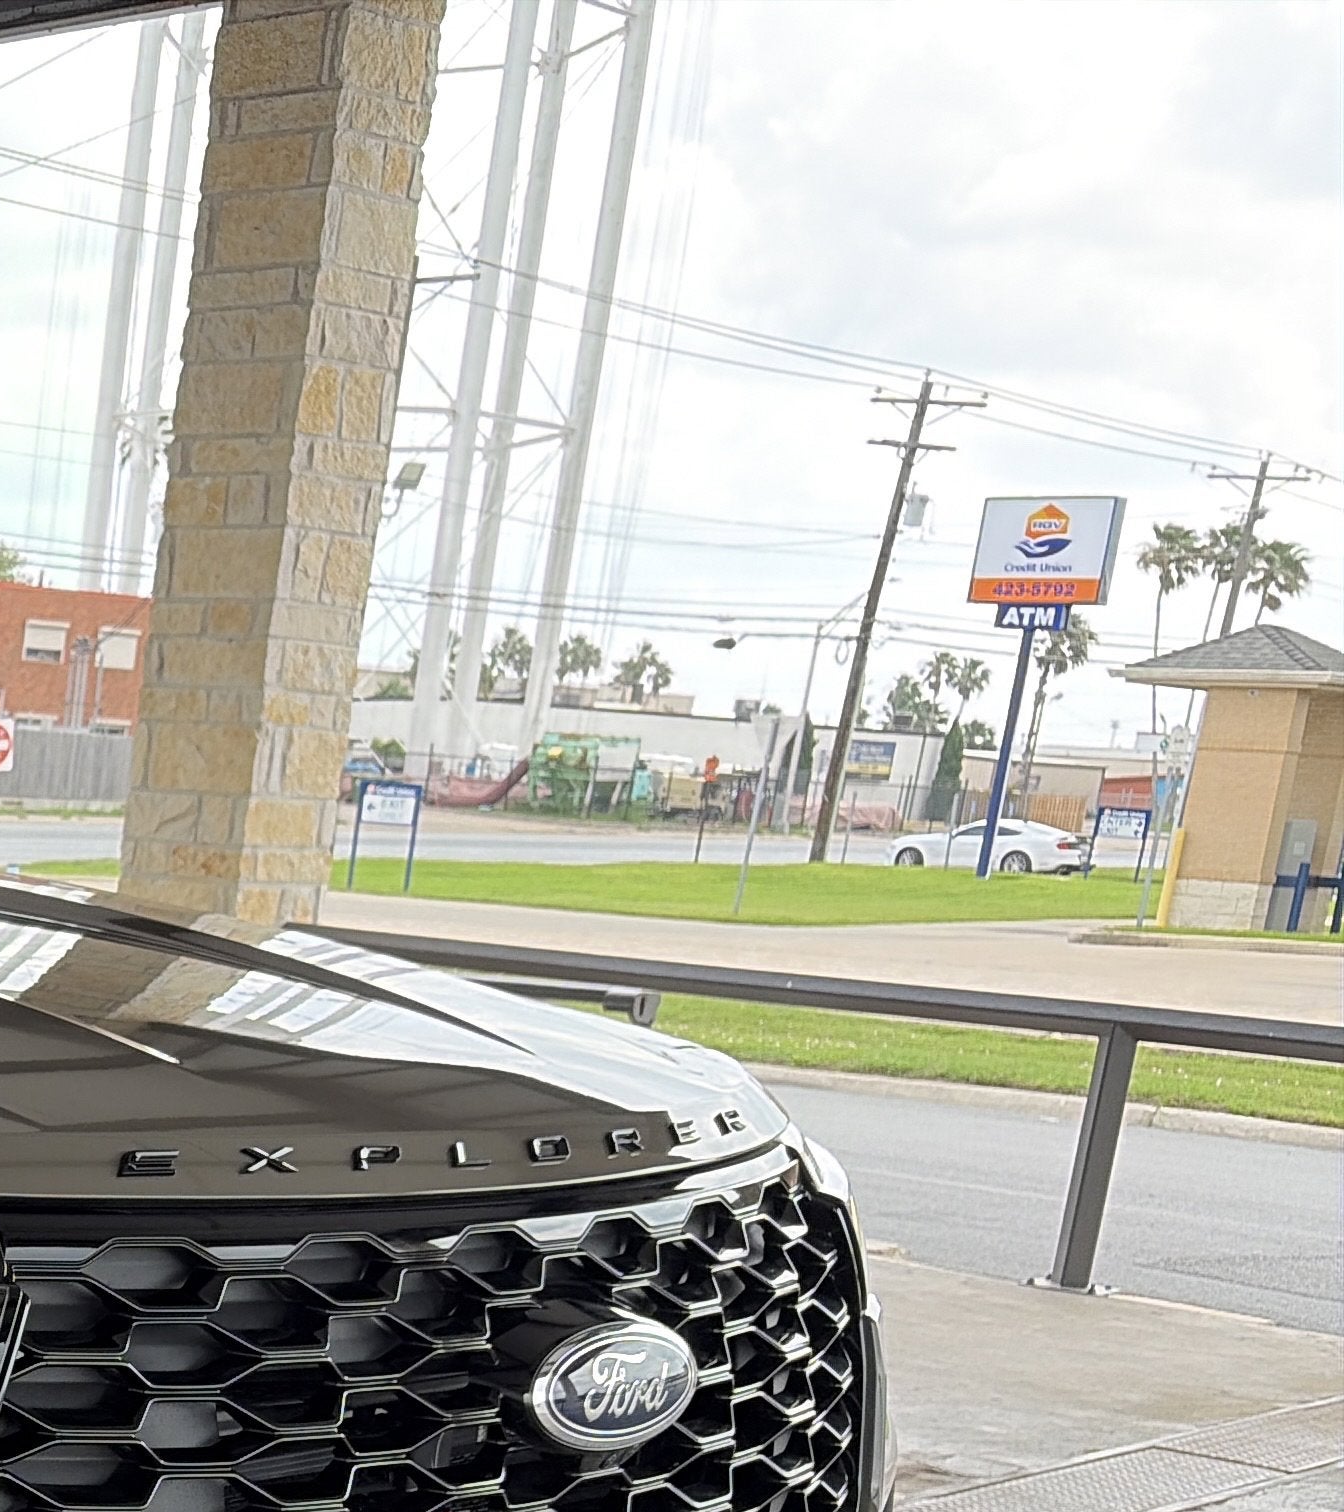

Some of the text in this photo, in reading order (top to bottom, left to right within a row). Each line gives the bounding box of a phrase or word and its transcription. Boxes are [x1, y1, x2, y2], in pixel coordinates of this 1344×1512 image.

[1032, 520, 1063, 530] RGV
[1004, 563, 1072, 572] Credit Union
[1002, 606, 1057, 627] ATM
[117, 1109, 747, 1178] EXPLORER
[583, 1351, 671, 1423] Ford
